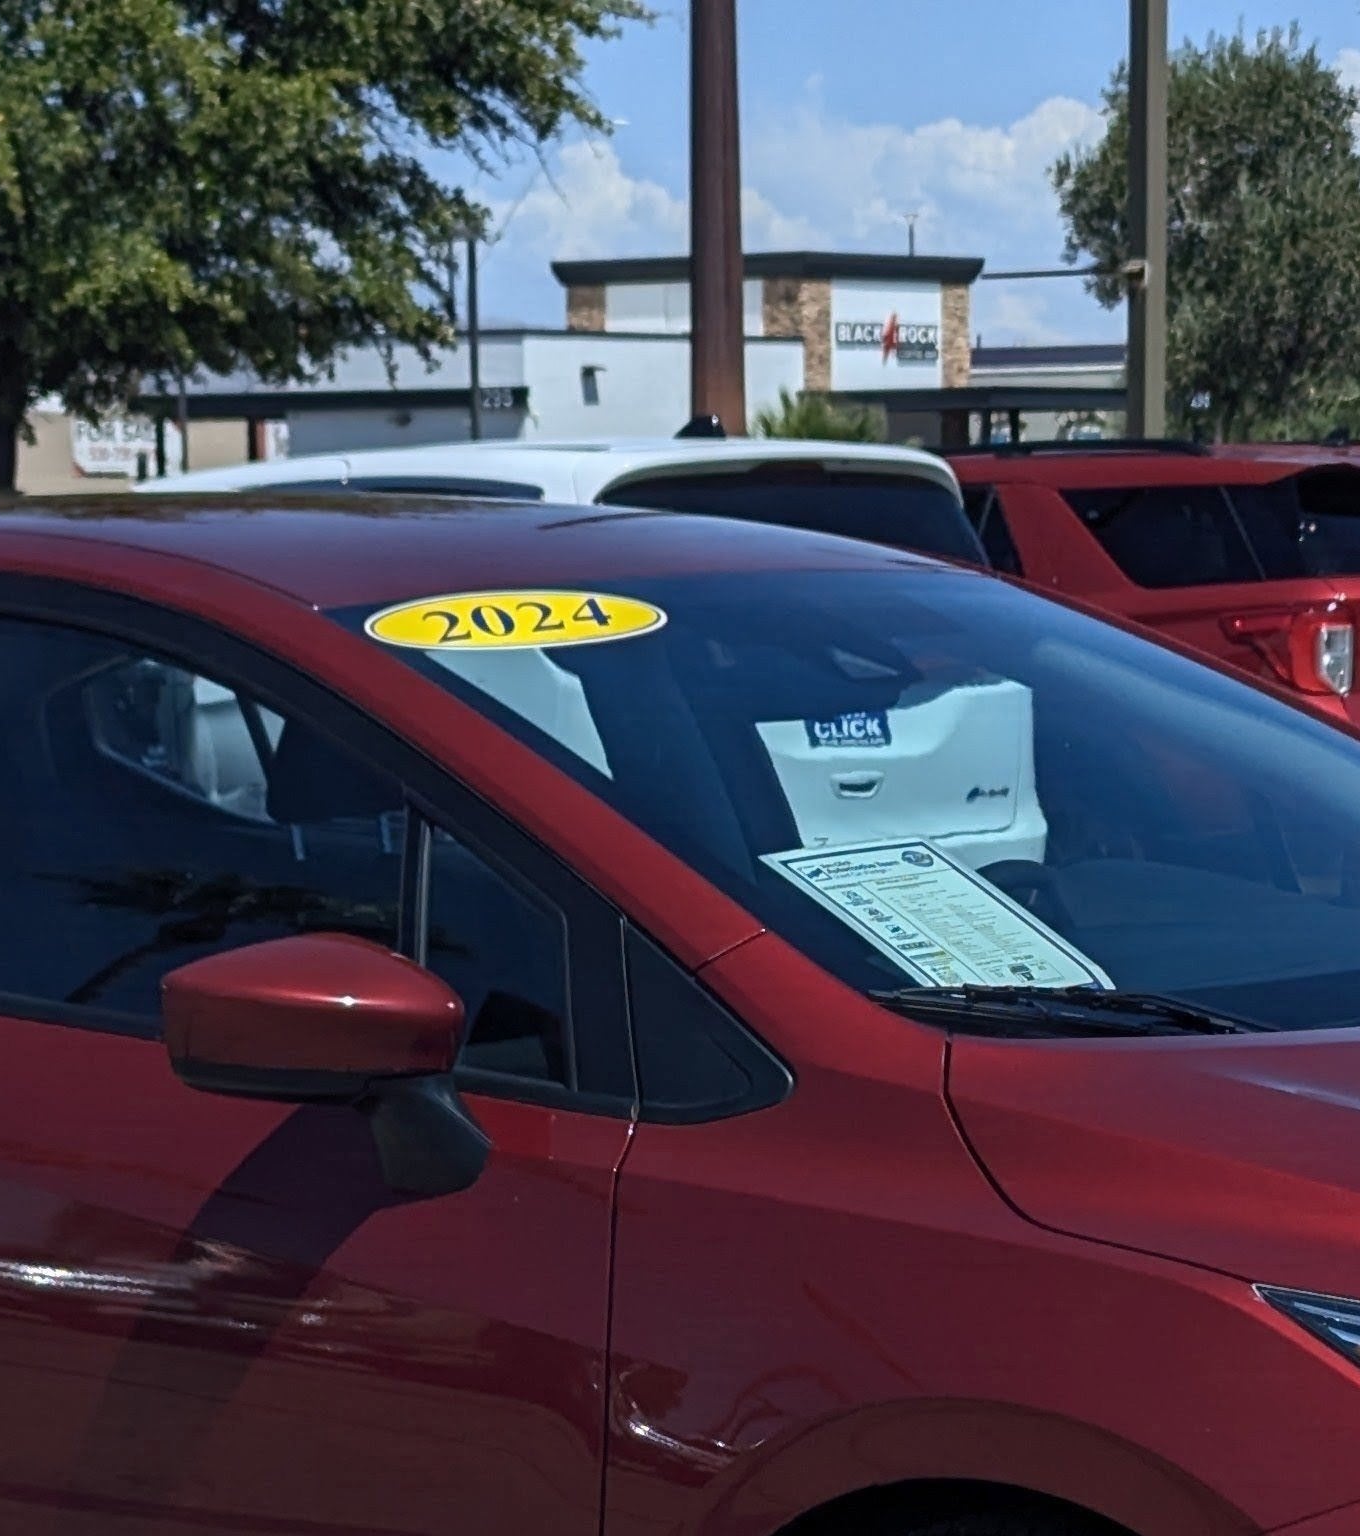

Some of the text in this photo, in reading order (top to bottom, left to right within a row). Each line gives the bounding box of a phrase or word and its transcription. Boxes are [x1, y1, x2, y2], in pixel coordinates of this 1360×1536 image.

[837, 323, 937, 344] BLACK ROCK
[422, 598, 612, 644] 2024
[814, 716, 882, 738] CLICK
